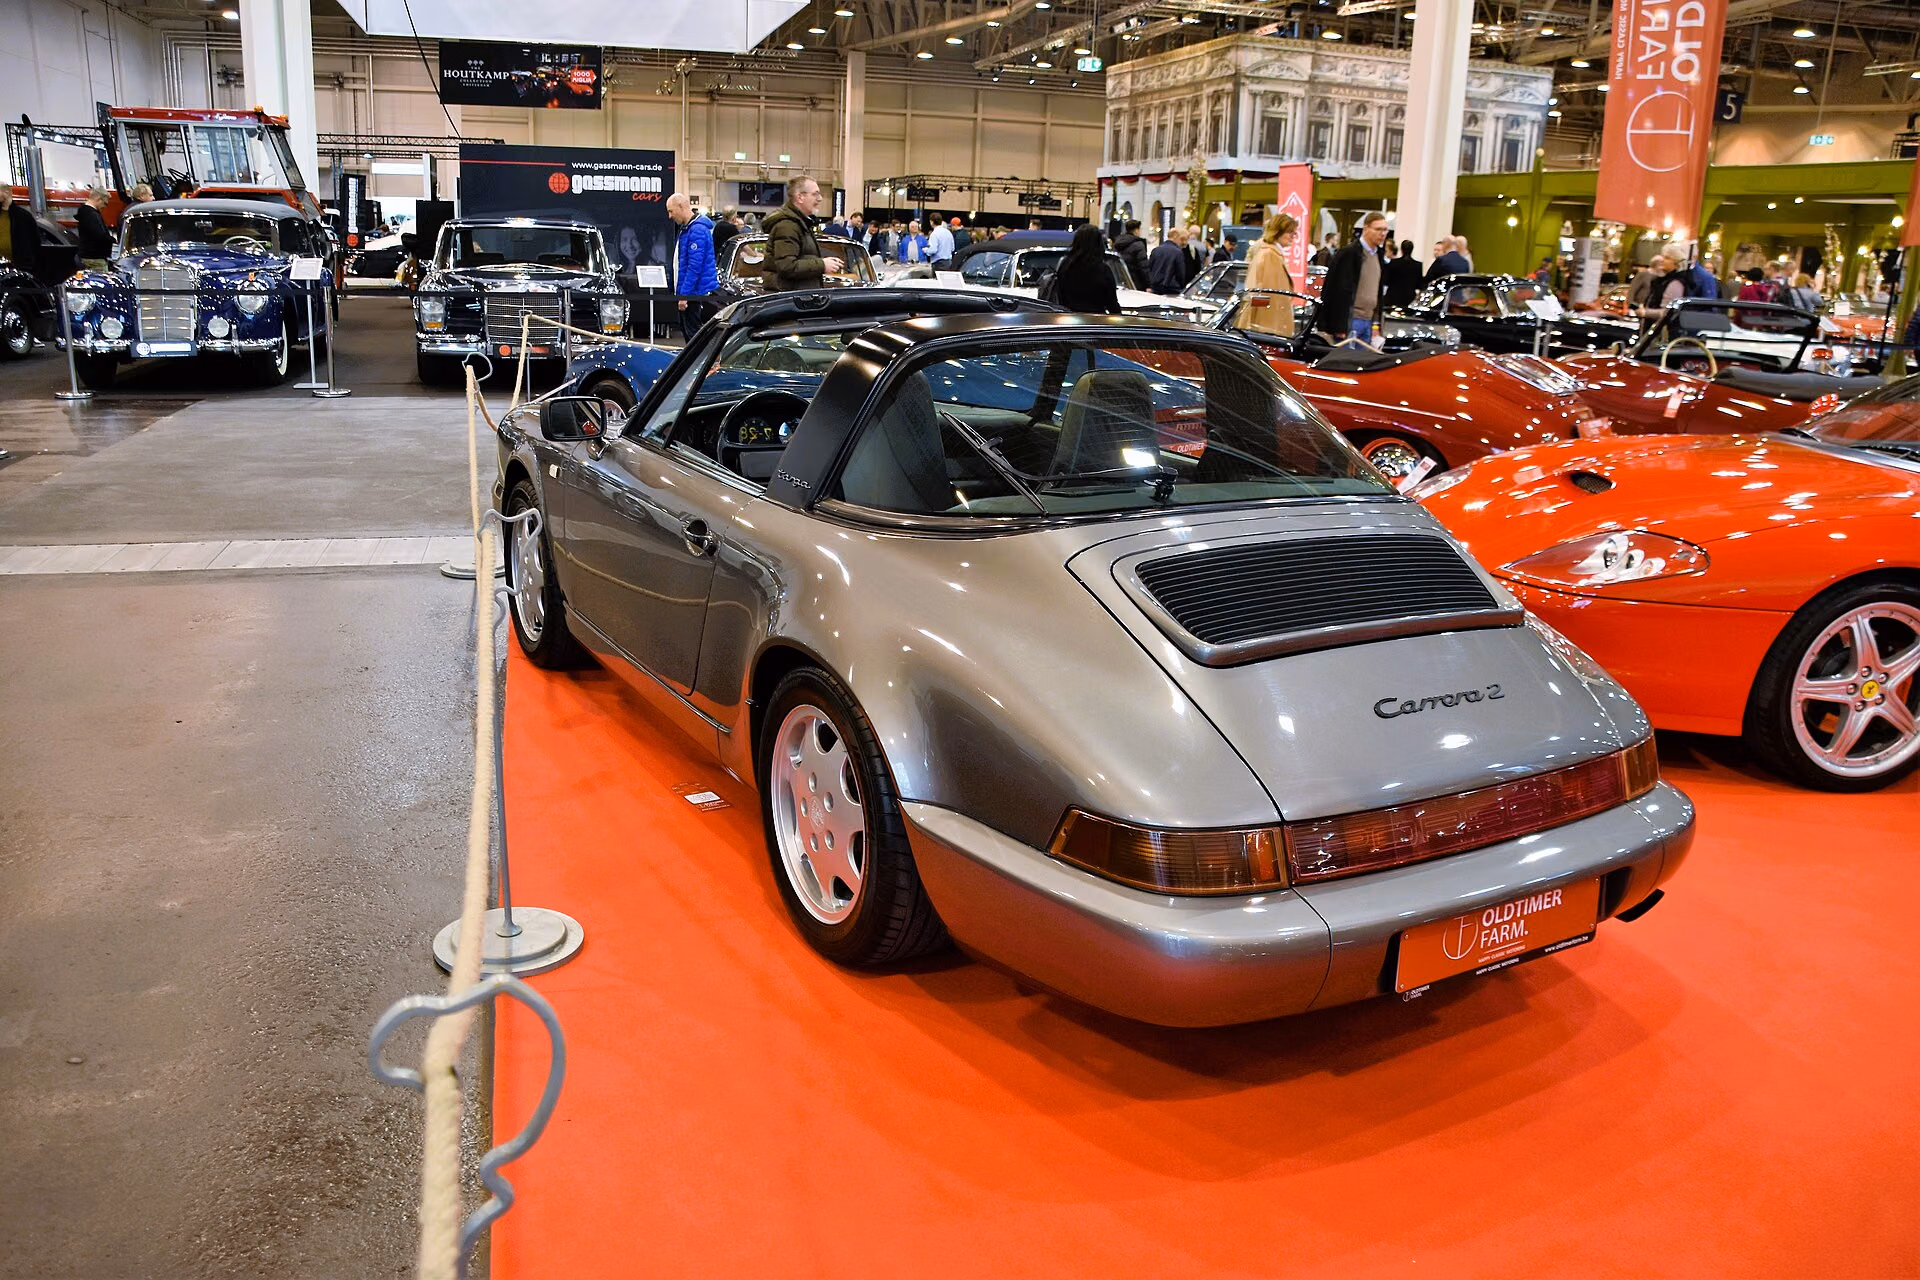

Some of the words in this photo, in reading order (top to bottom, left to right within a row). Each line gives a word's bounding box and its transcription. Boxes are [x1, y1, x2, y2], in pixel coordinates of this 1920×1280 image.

[443, 69, 510, 80] HOUTKAMP
[1722, 94, 1737, 120] 5
[571, 161, 663, 171] www.gassmann-cars.de
[571, 174, 662, 194] gassmann
[632, 192, 662, 202] cars
[1373, 689, 1484, 720] Carrera
[1486, 684, 1505, 700] 2
[1482, 889, 1562, 927] OLDTIMER
